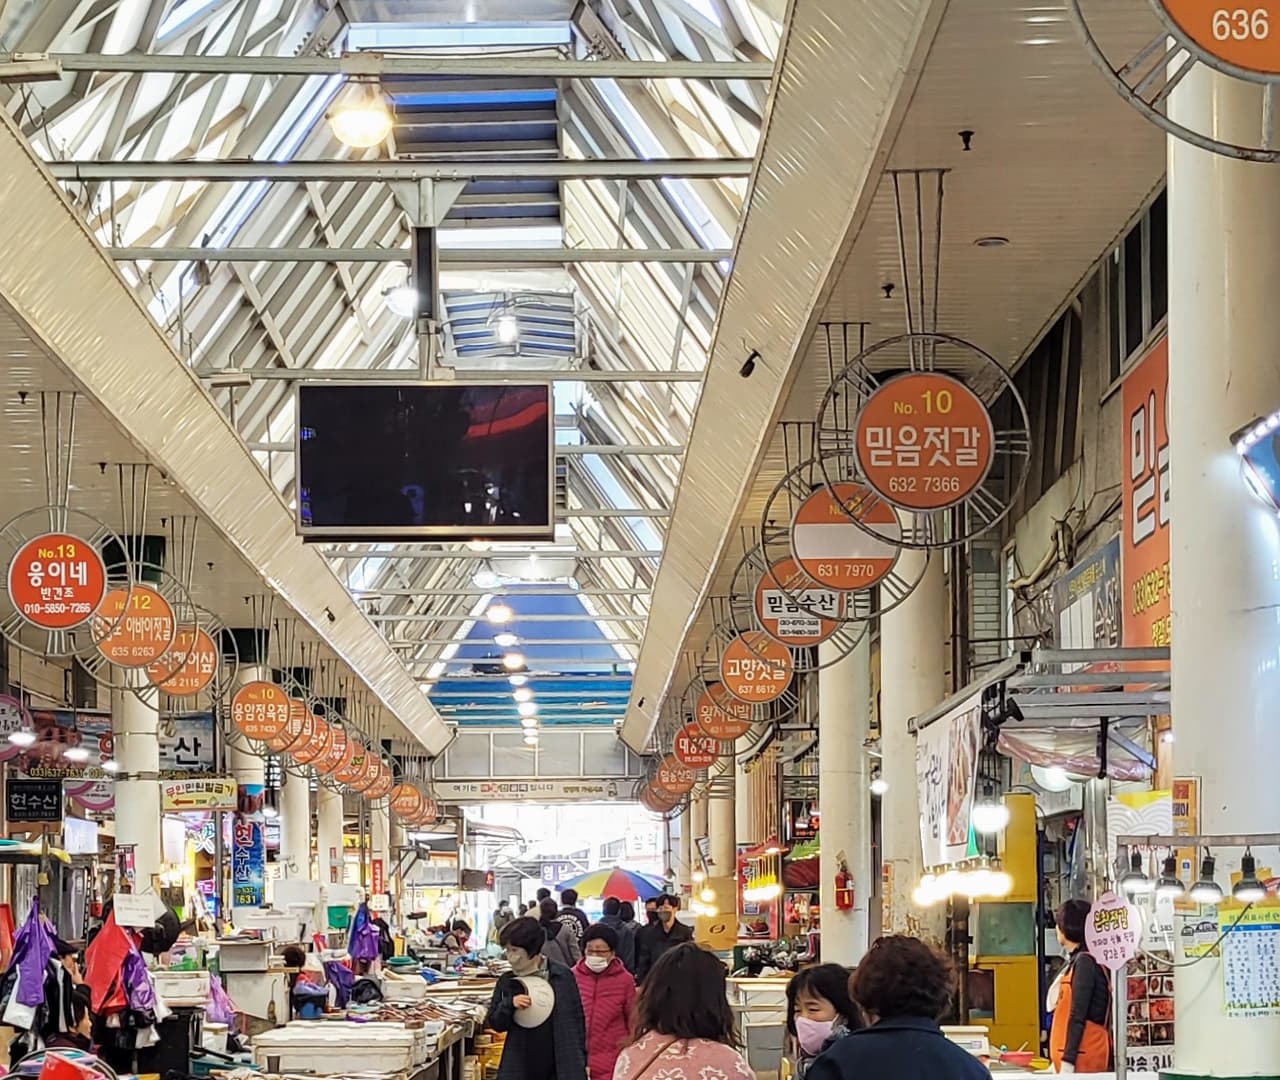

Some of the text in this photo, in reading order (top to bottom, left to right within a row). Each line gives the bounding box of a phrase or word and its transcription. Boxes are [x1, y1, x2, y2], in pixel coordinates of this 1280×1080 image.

[1211, 8, 1270, 41] 636
[920, 389, 953, 415] 10
[865, 425, 981, 468] 믿음젓갈
[889, 476, 960, 493] 632 7366
[817, 563, 874, 578] 631 7970
[23, 601, 92, 615] 010-5850-7266
[131, 594, 152, 610] 12
[125, 616, 172, 642] 아바이젓갈
[111, 646, 155, 657] 635 6263
[179, 678, 200, 687] 2115
[9, 792, 58, 811] 현수산
